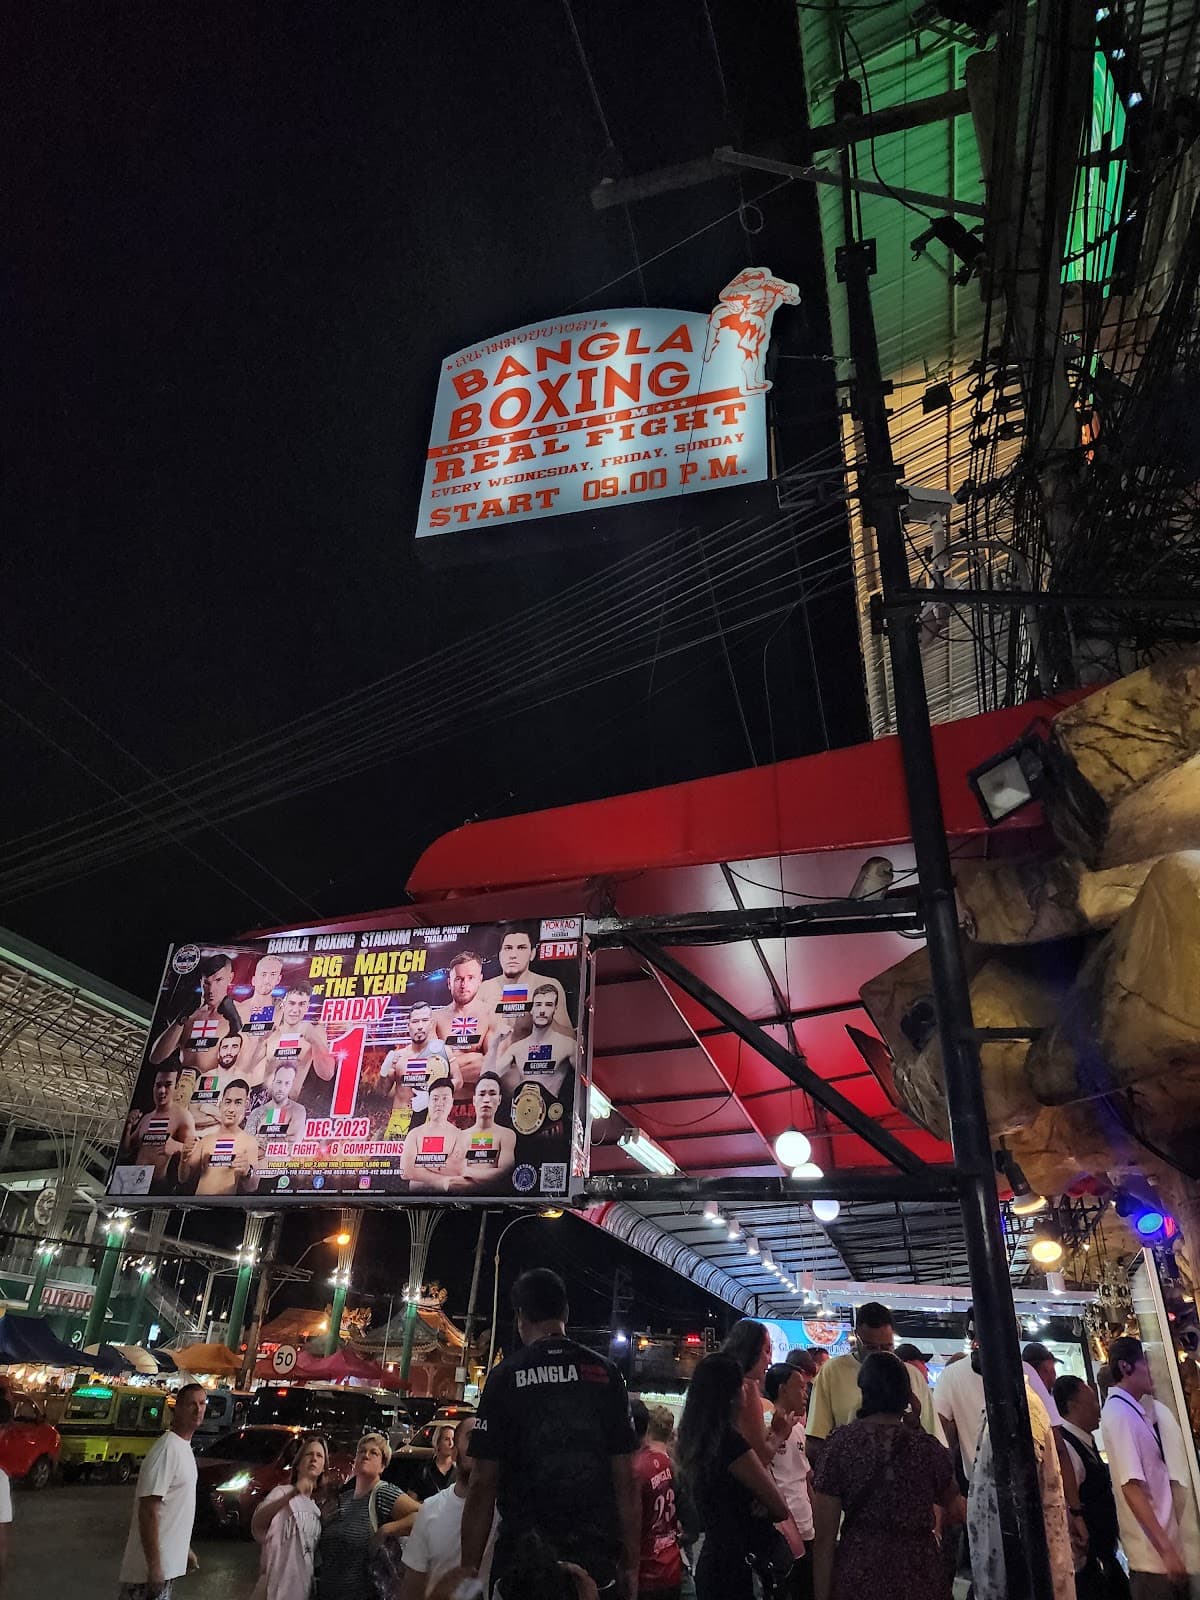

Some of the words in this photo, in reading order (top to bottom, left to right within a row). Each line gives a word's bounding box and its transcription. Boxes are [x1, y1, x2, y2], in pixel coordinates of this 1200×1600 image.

[451, 324, 693, 401] BANGLA
[448, 361, 690, 441] BOXING
[477, 406, 650, 448] STADIUM
[432, 439, 569, 485] REAL
[585, 402, 746, 448] FIGHT
[431, 482, 481, 499] EVERY
[675, 433, 744, 454] SUNDAY
[429, 488, 560, 528] START
[582, 467, 667, 501] 09.00
[679, 455, 748, 484] P.M.
[267, 937, 309, 954] BANGLA
[314, 933, 355, 950] BOXING
[361, 928, 412, 947] STADIUM
[413, 927, 440, 937] PATONG
[442, 925, 470, 935] PHUKET
[424, 934, 457, 944] THAILAND
[309, 955, 344, 978] BIG
[354, 950, 427, 976] MATCH
[545, 944, 553, 958] 9
[556, 943, 578, 957] PM
[312, 984, 325, 995] OF
[325, 976, 357, 998] THE
[362, 974, 409, 996] YEAR
[321, 996, 391, 1021] FRIDAY
[330, 1026, 364, 1117] 1
[267, 1144, 288, 1155] REAL
[293, 1143, 317, 1155] FIGHT
[275, 1352, 293, 1366] 50
[515, 1364, 578, 1388] BANGLA
[652, 1488, 677, 1529] 23
